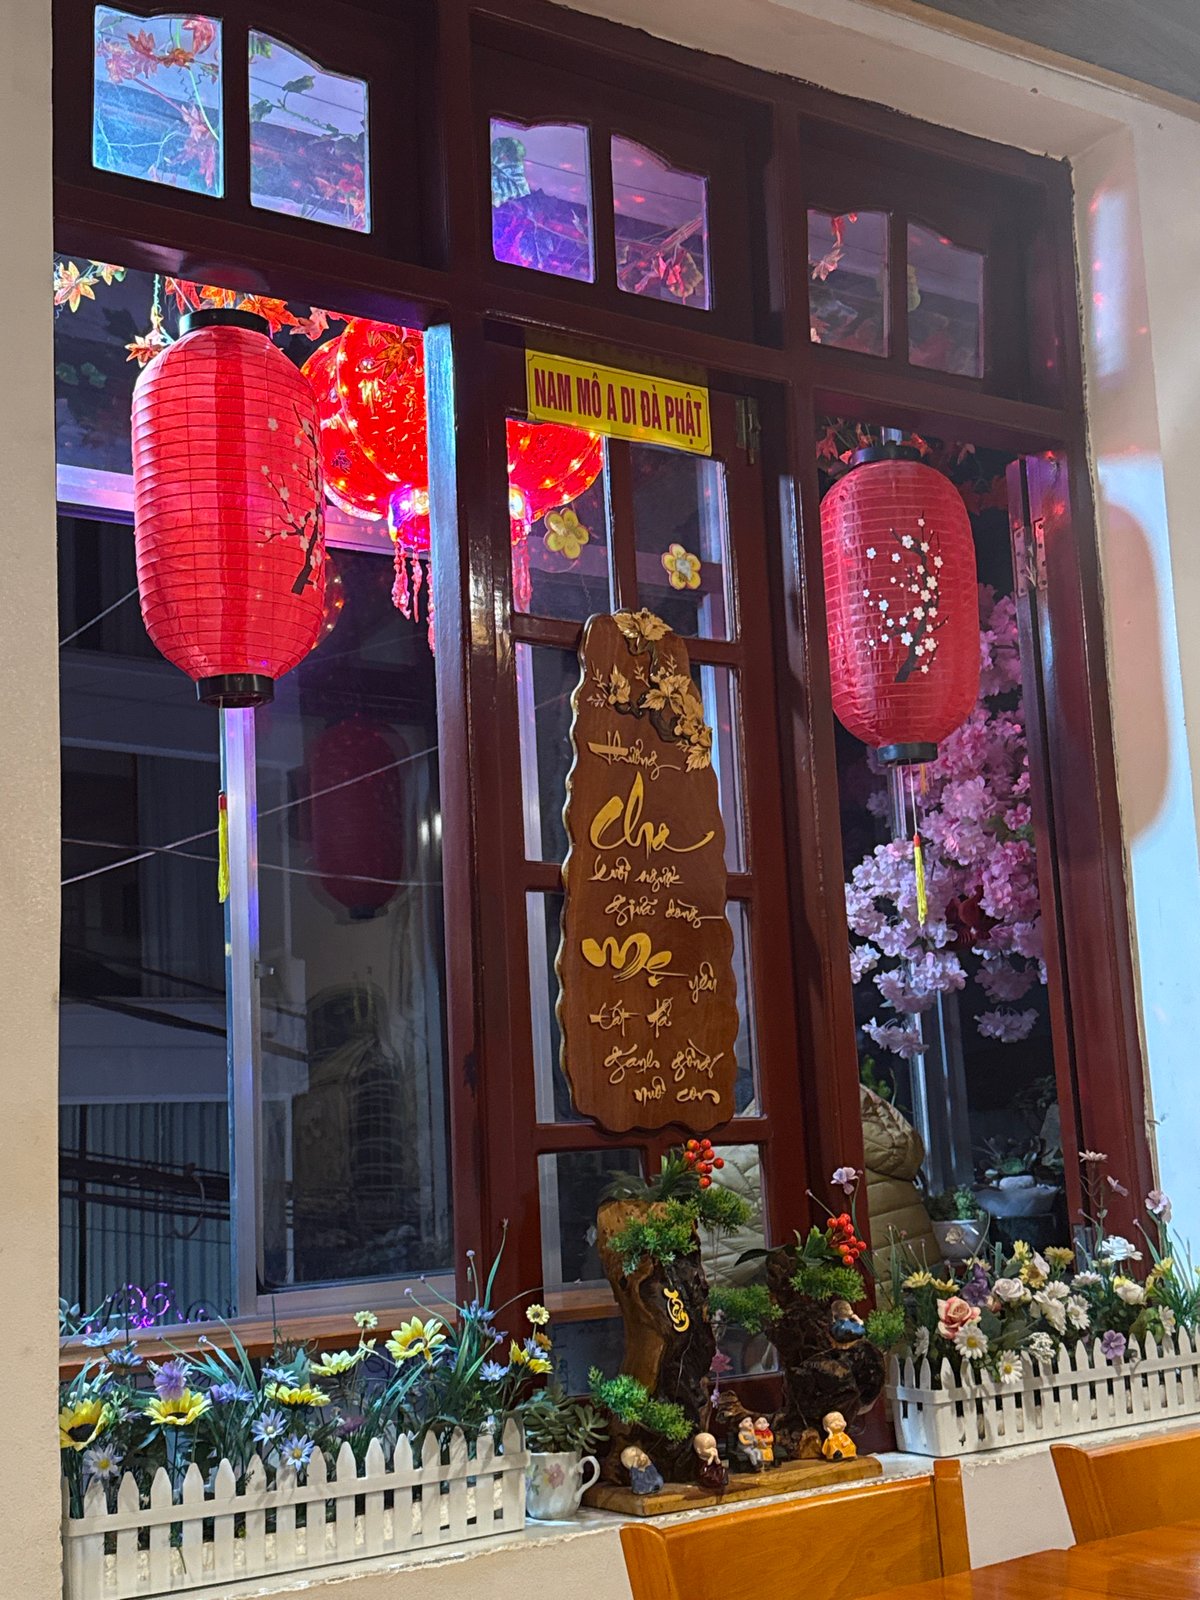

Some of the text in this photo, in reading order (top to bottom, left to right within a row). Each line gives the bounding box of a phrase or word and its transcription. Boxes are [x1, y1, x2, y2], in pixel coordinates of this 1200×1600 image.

[534, 367, 702, 444] NAM MÔ A DI ĐÀ PHẬT
[689, 961, 717, 1004] yêu
[604, 1039, 725, 1084] gánh gồng
[676, 1088, 721, 1105] con
